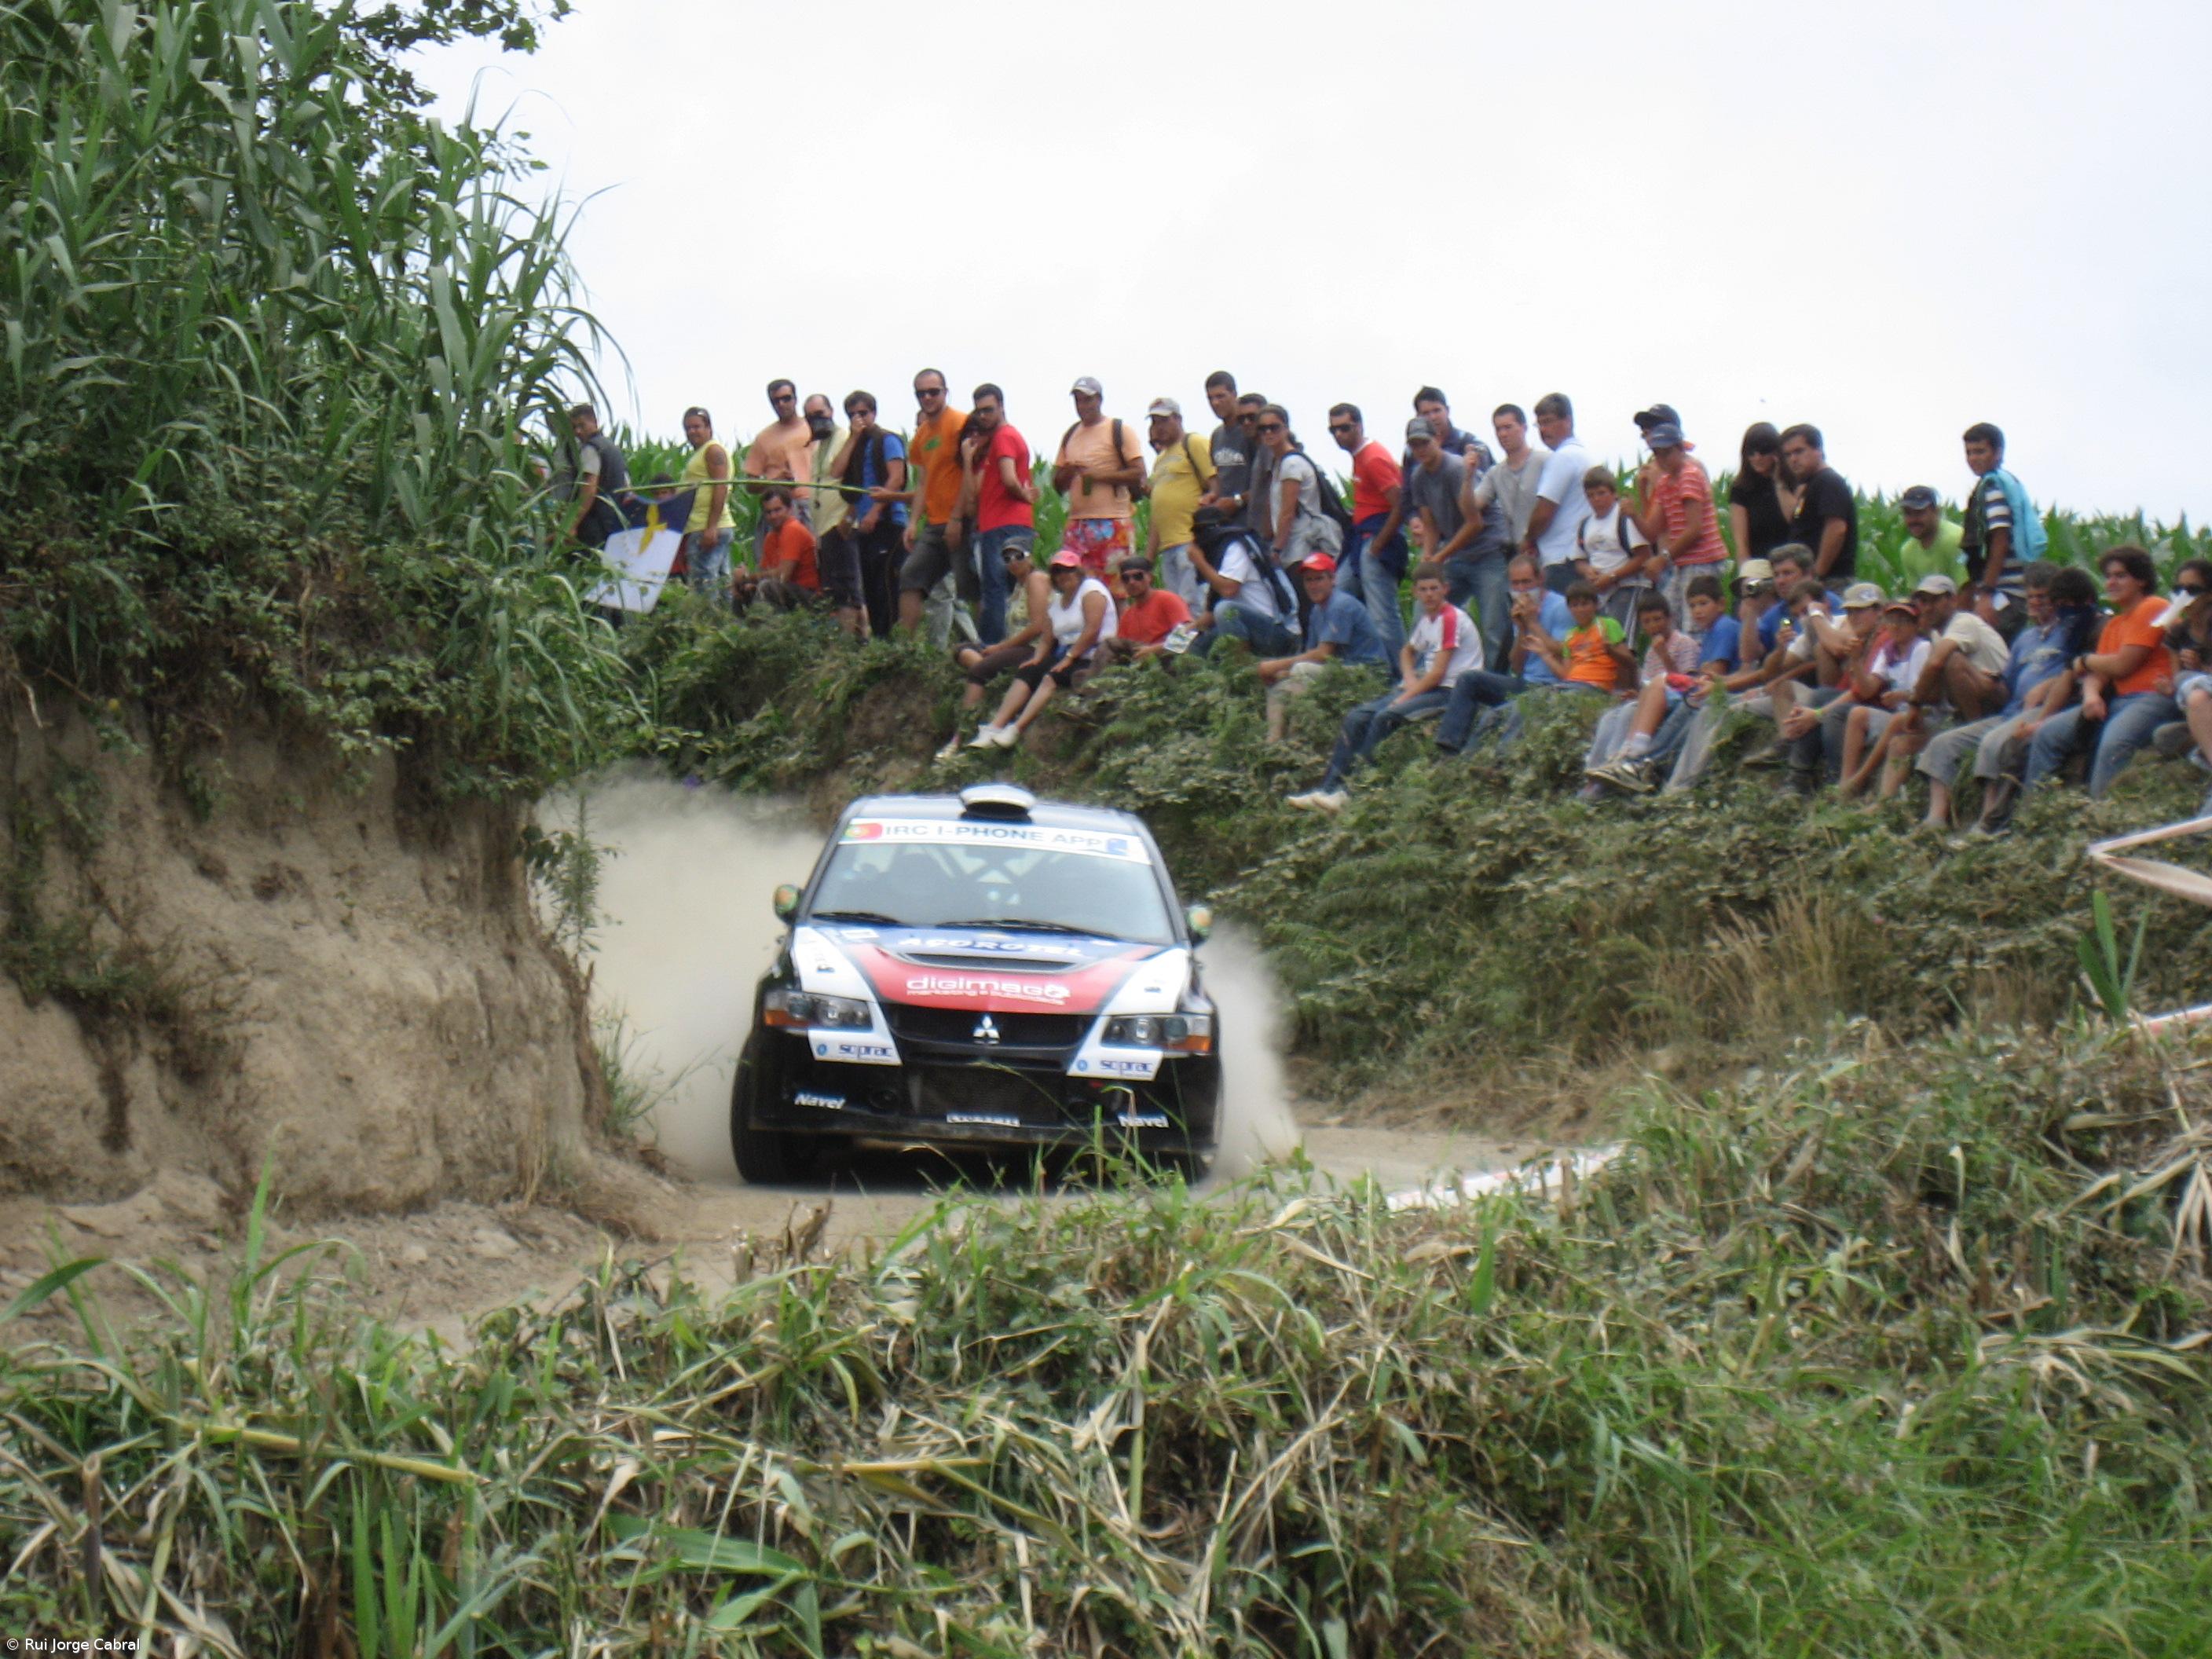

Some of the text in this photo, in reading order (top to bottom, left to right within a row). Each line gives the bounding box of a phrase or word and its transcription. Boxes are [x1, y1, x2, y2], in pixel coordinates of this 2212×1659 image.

[885, 825, 1103, 847] IRC I-PHONE APP
